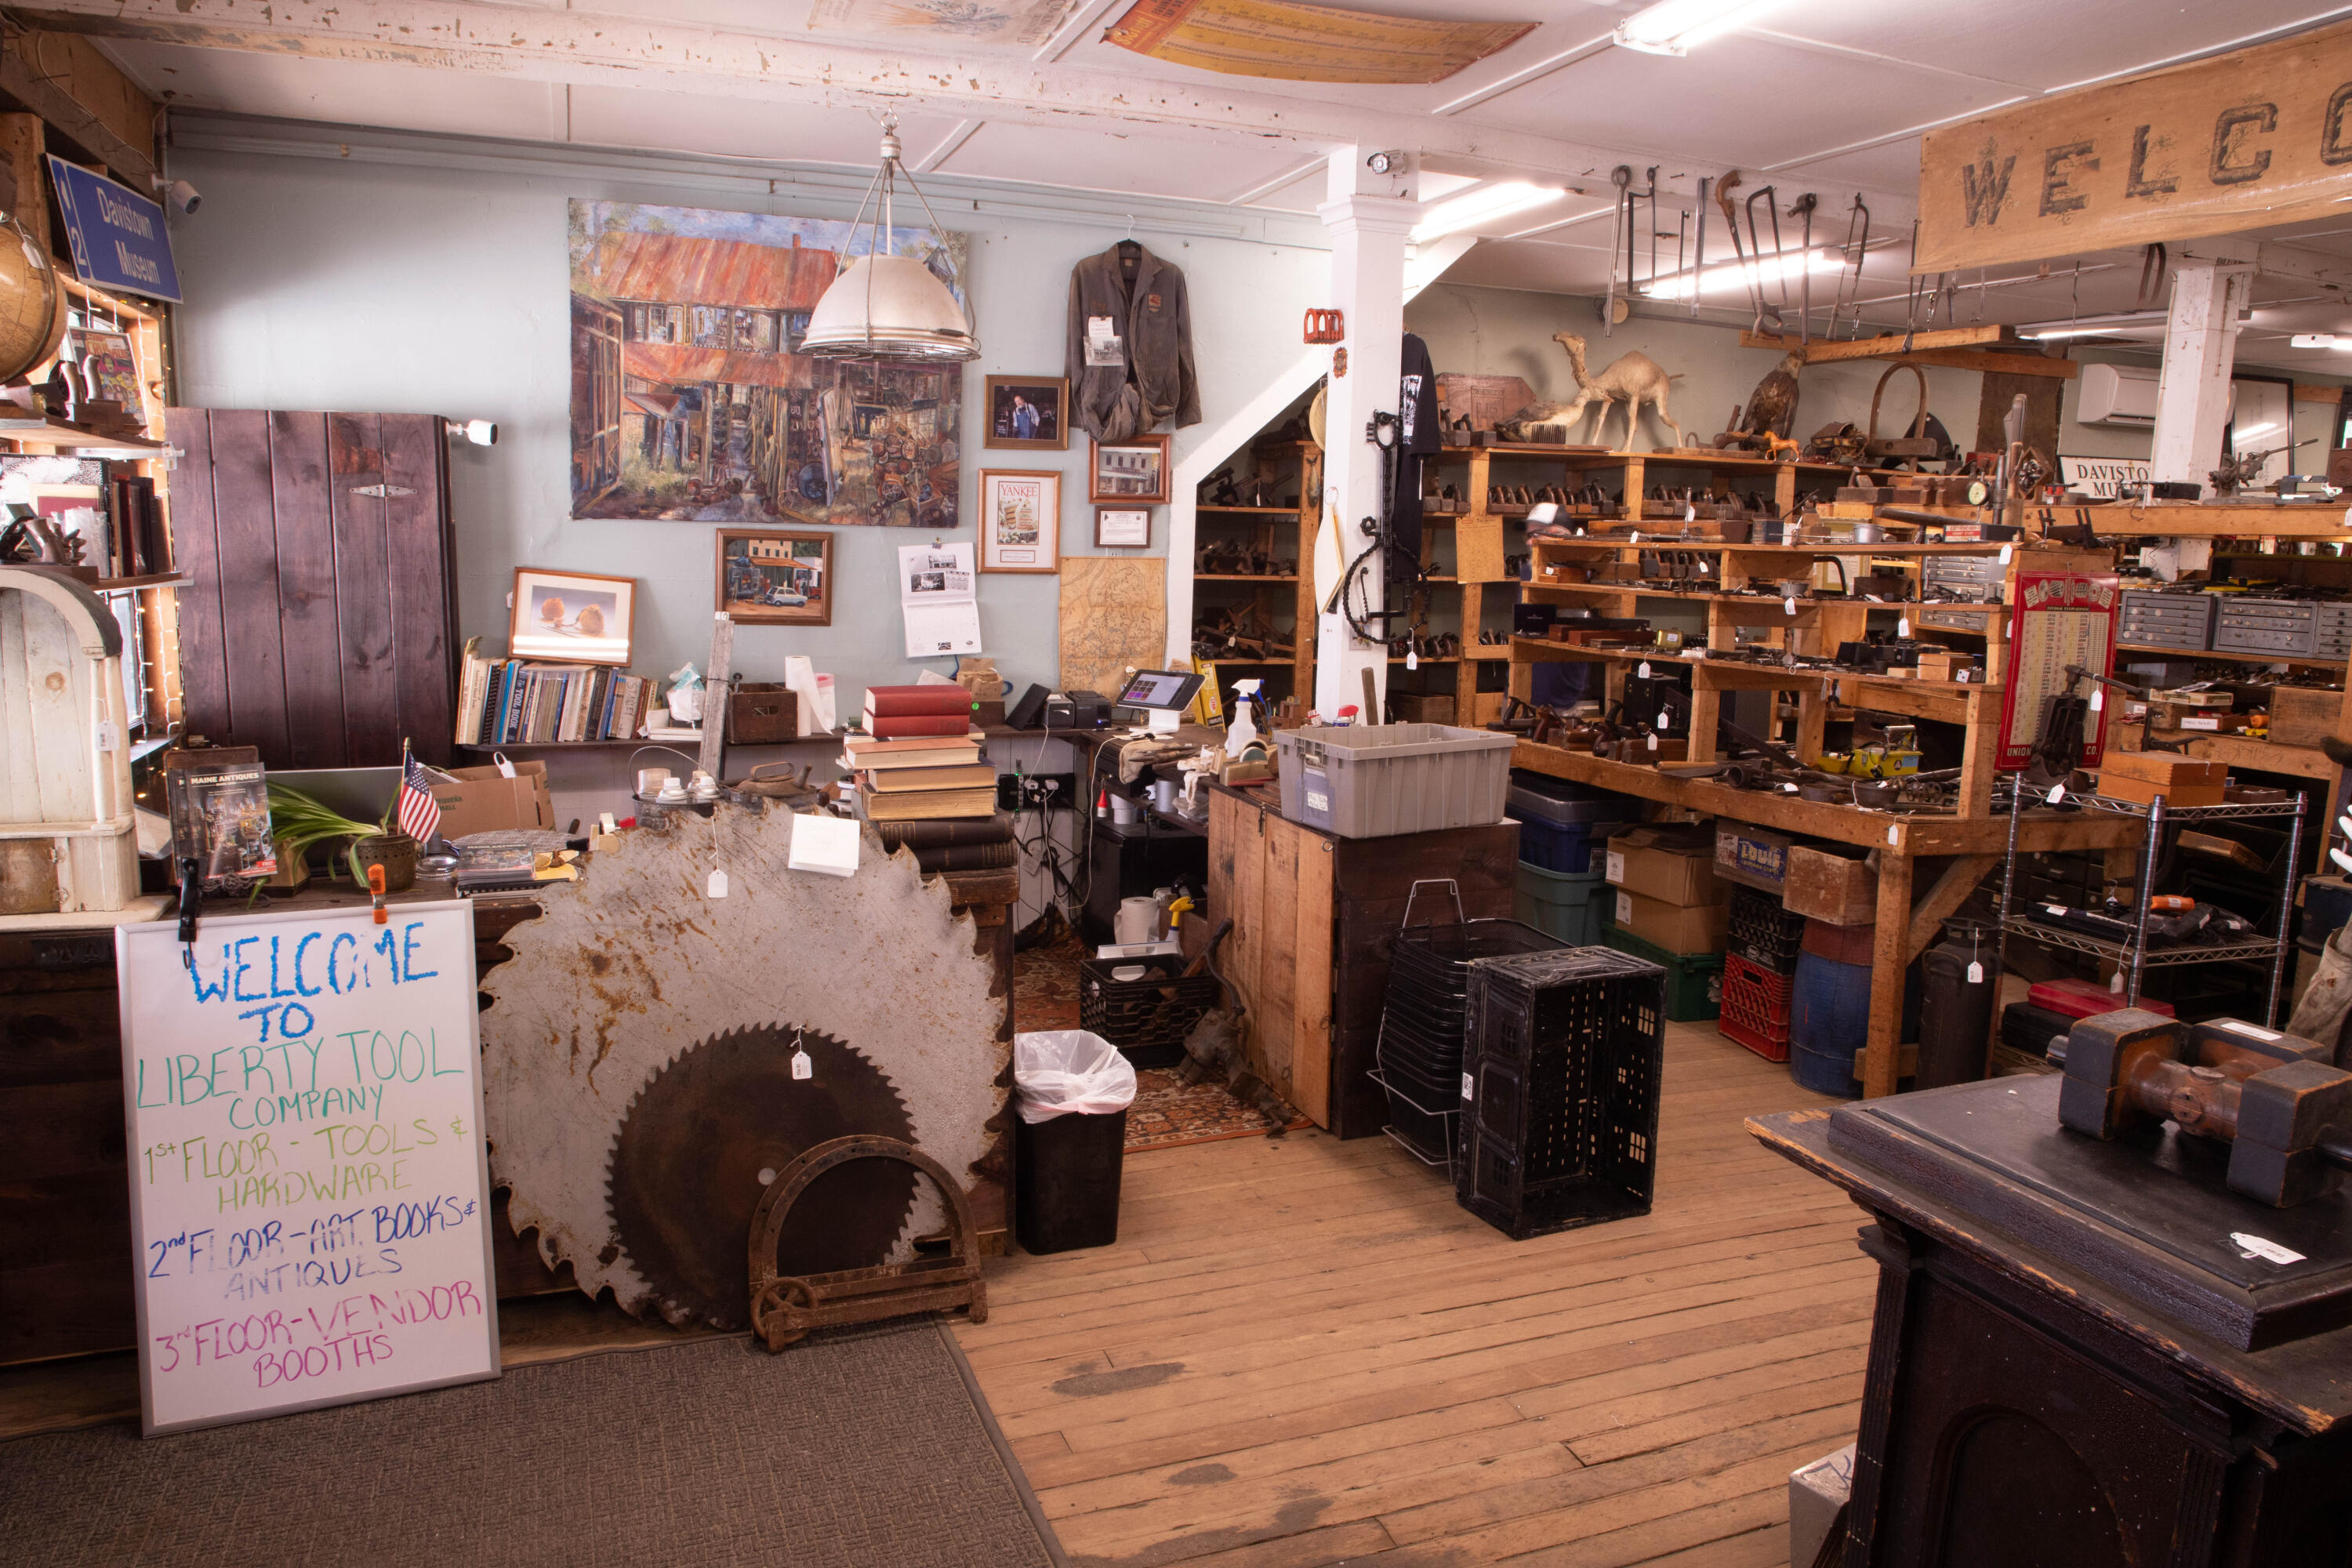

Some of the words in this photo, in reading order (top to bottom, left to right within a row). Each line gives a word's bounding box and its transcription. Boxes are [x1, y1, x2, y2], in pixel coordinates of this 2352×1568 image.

[96, 186, 154, 241] Davistown
[71, 226, 88, 266] 2
[114, 239, 162, 285] Museum
[1001, 484, 1038, 498] YANKEE
[2076, 464, 2149, 481] DAVISTO
[509, 708, 521, 728] BOOK
[513, 688, 524, 708] TOOL
[624, 682, 637, 716] STANLEY
[2006, 746, 2032, 757] UNION
[191, 776, 218, 785] MAINE
[219, 772, 260, 782] ANTIQUES
[187, 922, 438, 1004] WELCOME
[238, 1002, 314, 1043] TO
[136, 1037, 324, 1109] LIBERTY
[336, 1027, 465, 1083] TOOL
[229, 1083, 383, 1130] COMPANY
[182, 1132, 279, 1182] FLOOR
[313, 1119, 438, 1160] TOOLS
[218, 1159, 413, 1214] HARDWARE
[148, 1230, 187, 1279] 2nd
[223, 1248, 403, 1301] ANTIQUES
[252, 1334, 394, 1388] BOOTHS
